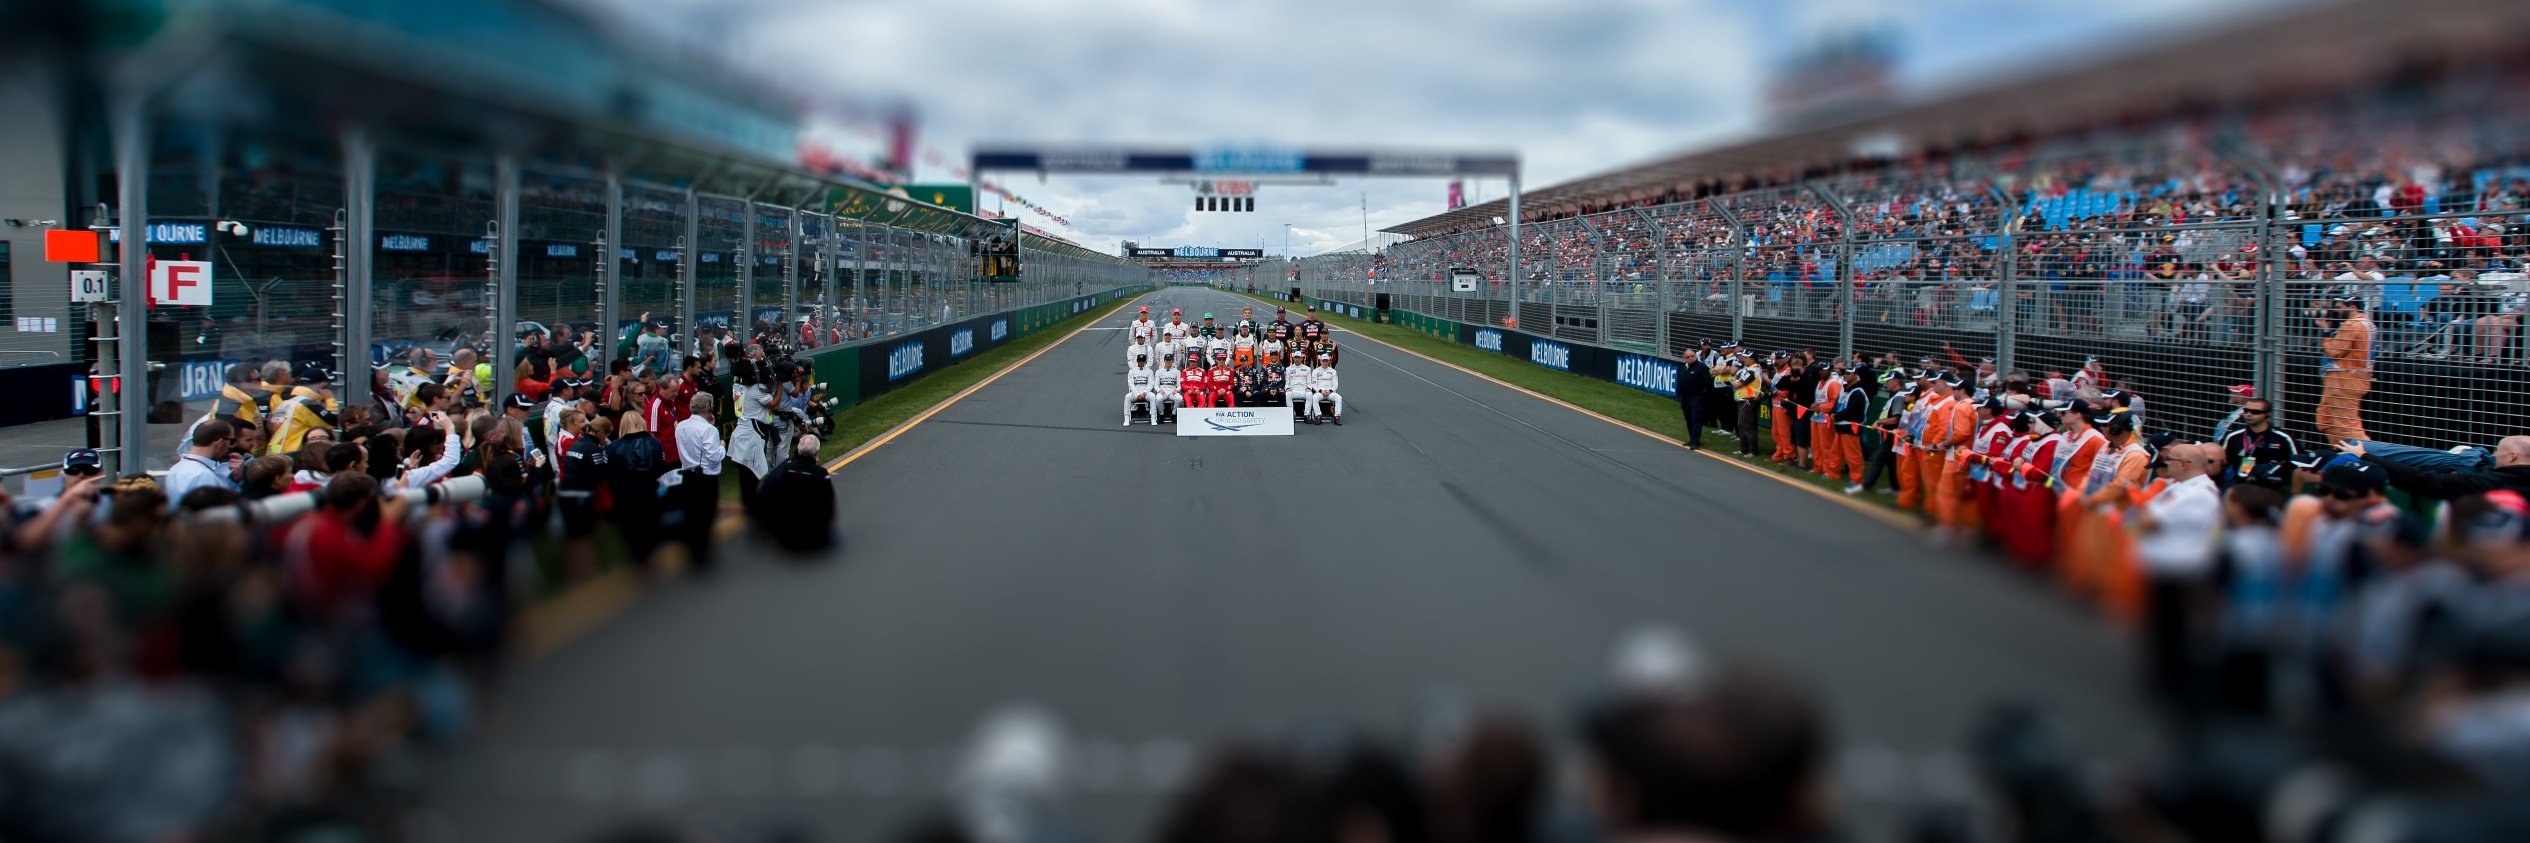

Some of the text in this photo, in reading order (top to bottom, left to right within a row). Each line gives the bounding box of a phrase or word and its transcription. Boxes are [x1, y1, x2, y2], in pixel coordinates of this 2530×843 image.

[253, 228, 319, 246] MELBOURNE
[1173, 247, 1218, 257] MELBOURNE
[83, 278, 104, 294] 0.1
[168, 266, 200, 300] F
[951, 328, 973, 356] MELBOURNE
[1475, 331, 1501, 351] MELBOURNE
[1531, 341, 1569, 368] MELBOURNE
[889, 342, 924, 378] MELBOURNE
[1617, 356, 1677, 393] MELBOURNE
